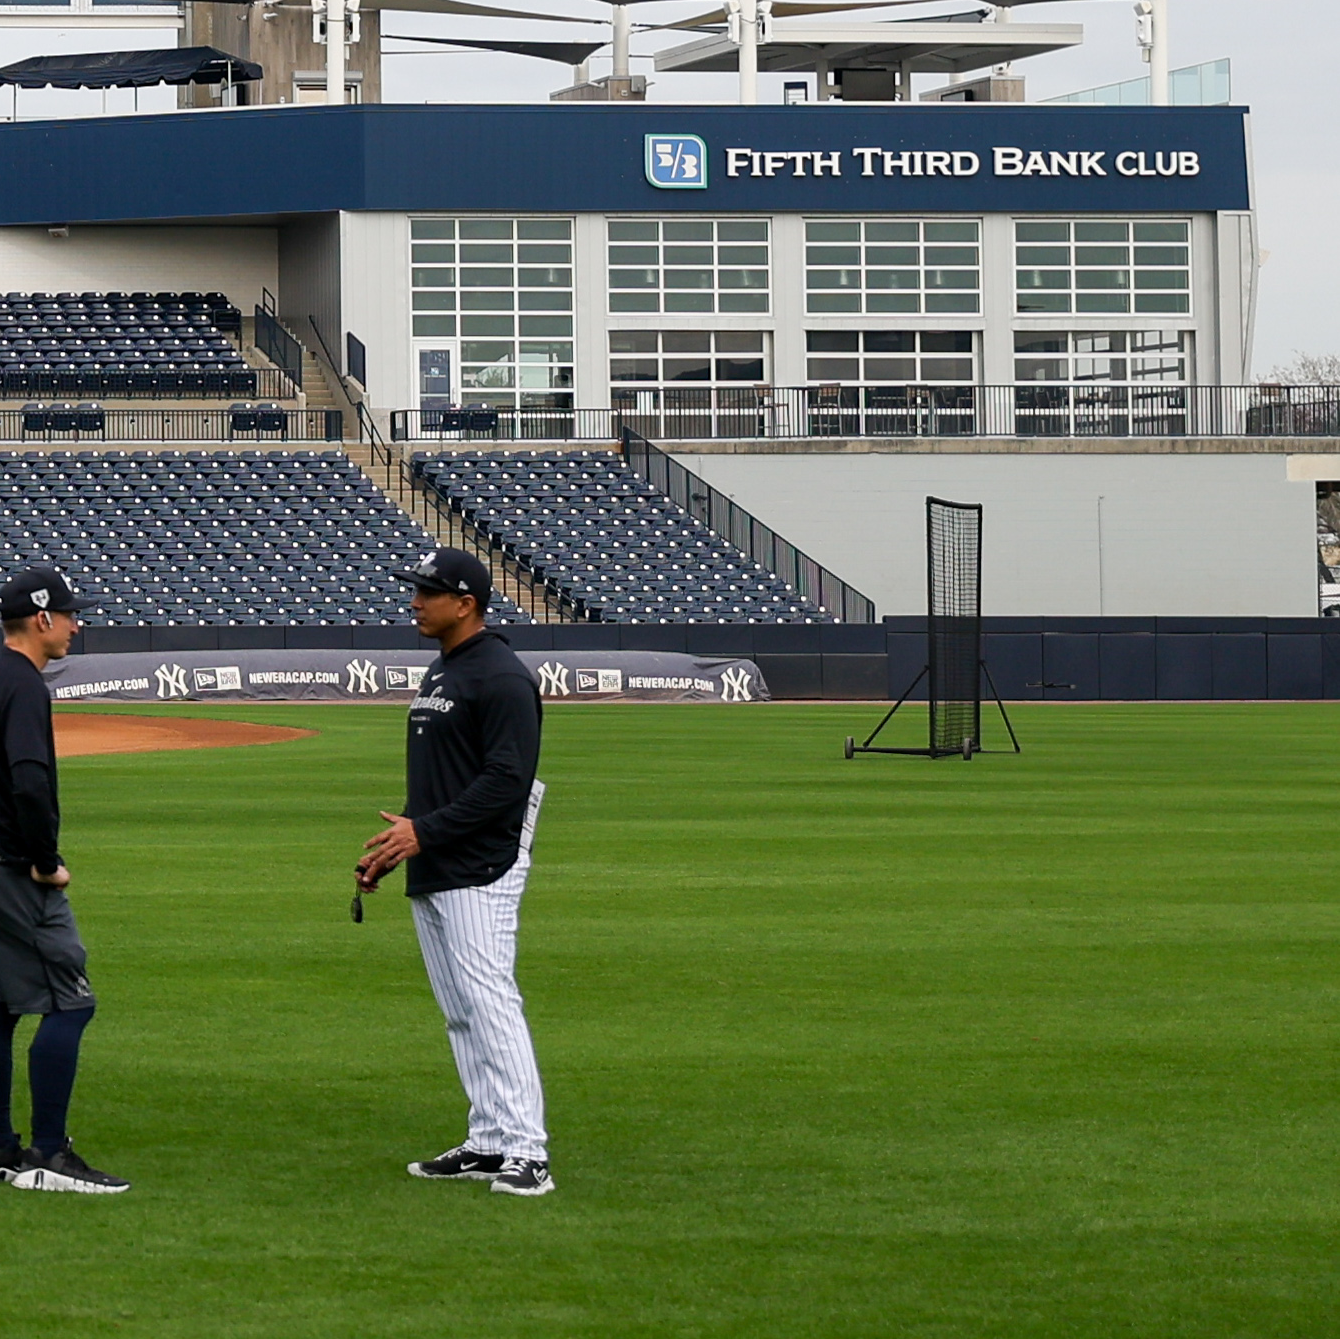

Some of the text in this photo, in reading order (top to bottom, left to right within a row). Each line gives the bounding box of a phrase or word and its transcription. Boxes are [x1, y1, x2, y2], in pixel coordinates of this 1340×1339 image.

[726, 147, 1200, 177] FIFTH THIRD BANK CLUB
[56, 677, 150, 699] NEWERACAP.COM
[248, 672, 340, 685] NEWERACAP.COM
[628, 676, 715, 693] NEWERACAP.COM
